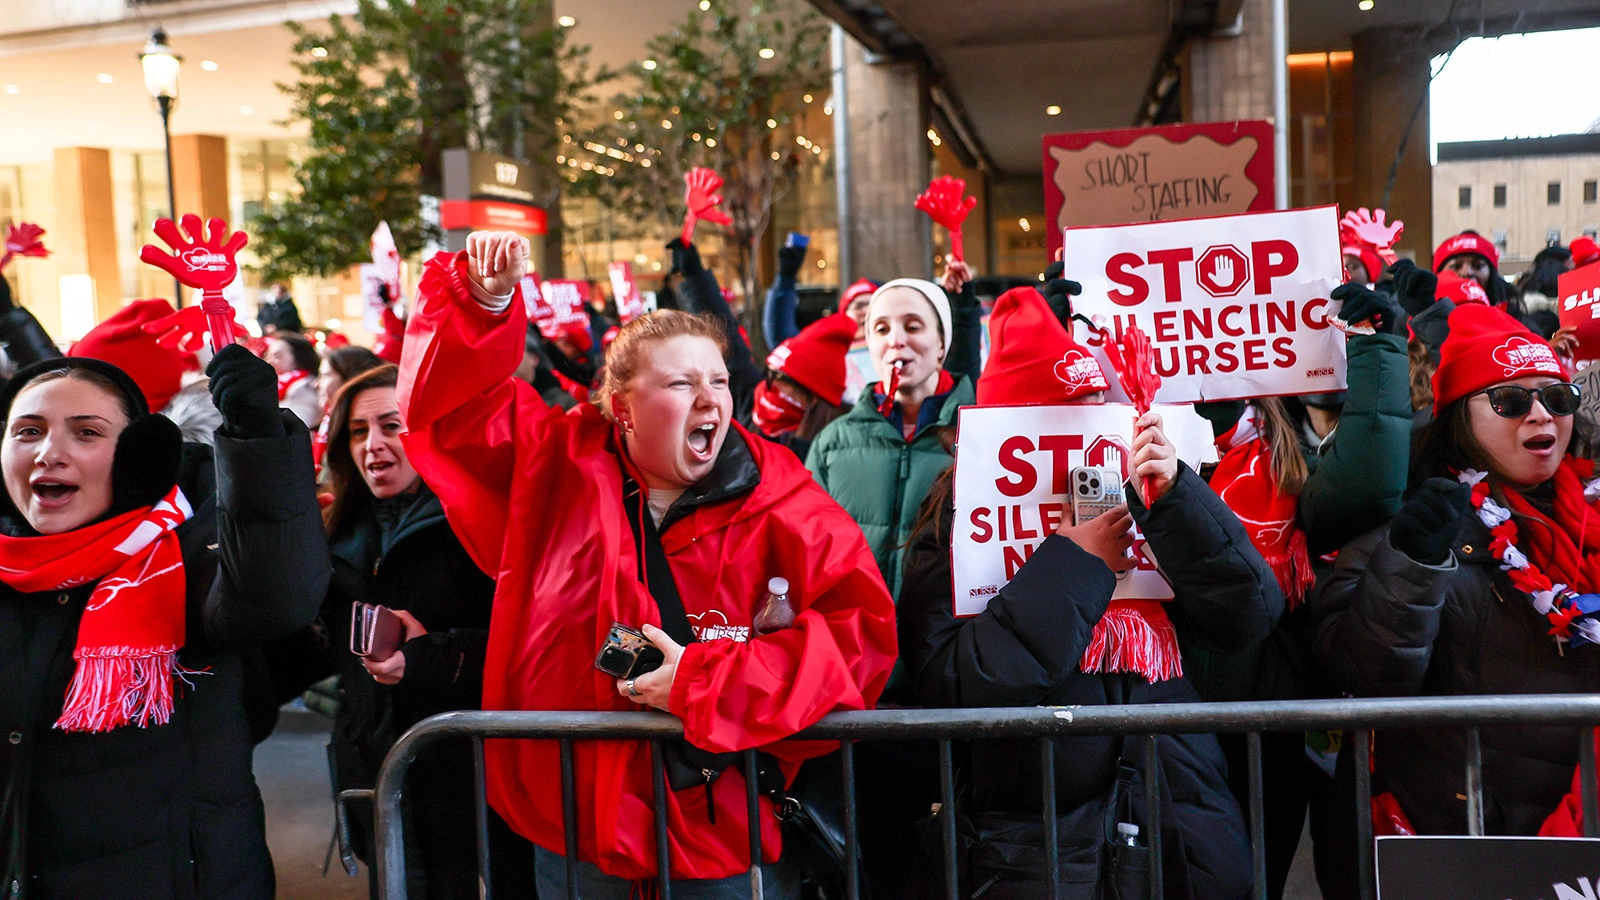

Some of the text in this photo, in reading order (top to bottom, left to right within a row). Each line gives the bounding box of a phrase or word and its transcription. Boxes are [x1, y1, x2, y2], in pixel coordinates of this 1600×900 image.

[1082, 152, 1149, 190] SHORT
[1132, 174, 1231, 213] STAFFING
[1105, 239, 1299, 306] STOP
[1150, 337, 1297, 378] URSES
